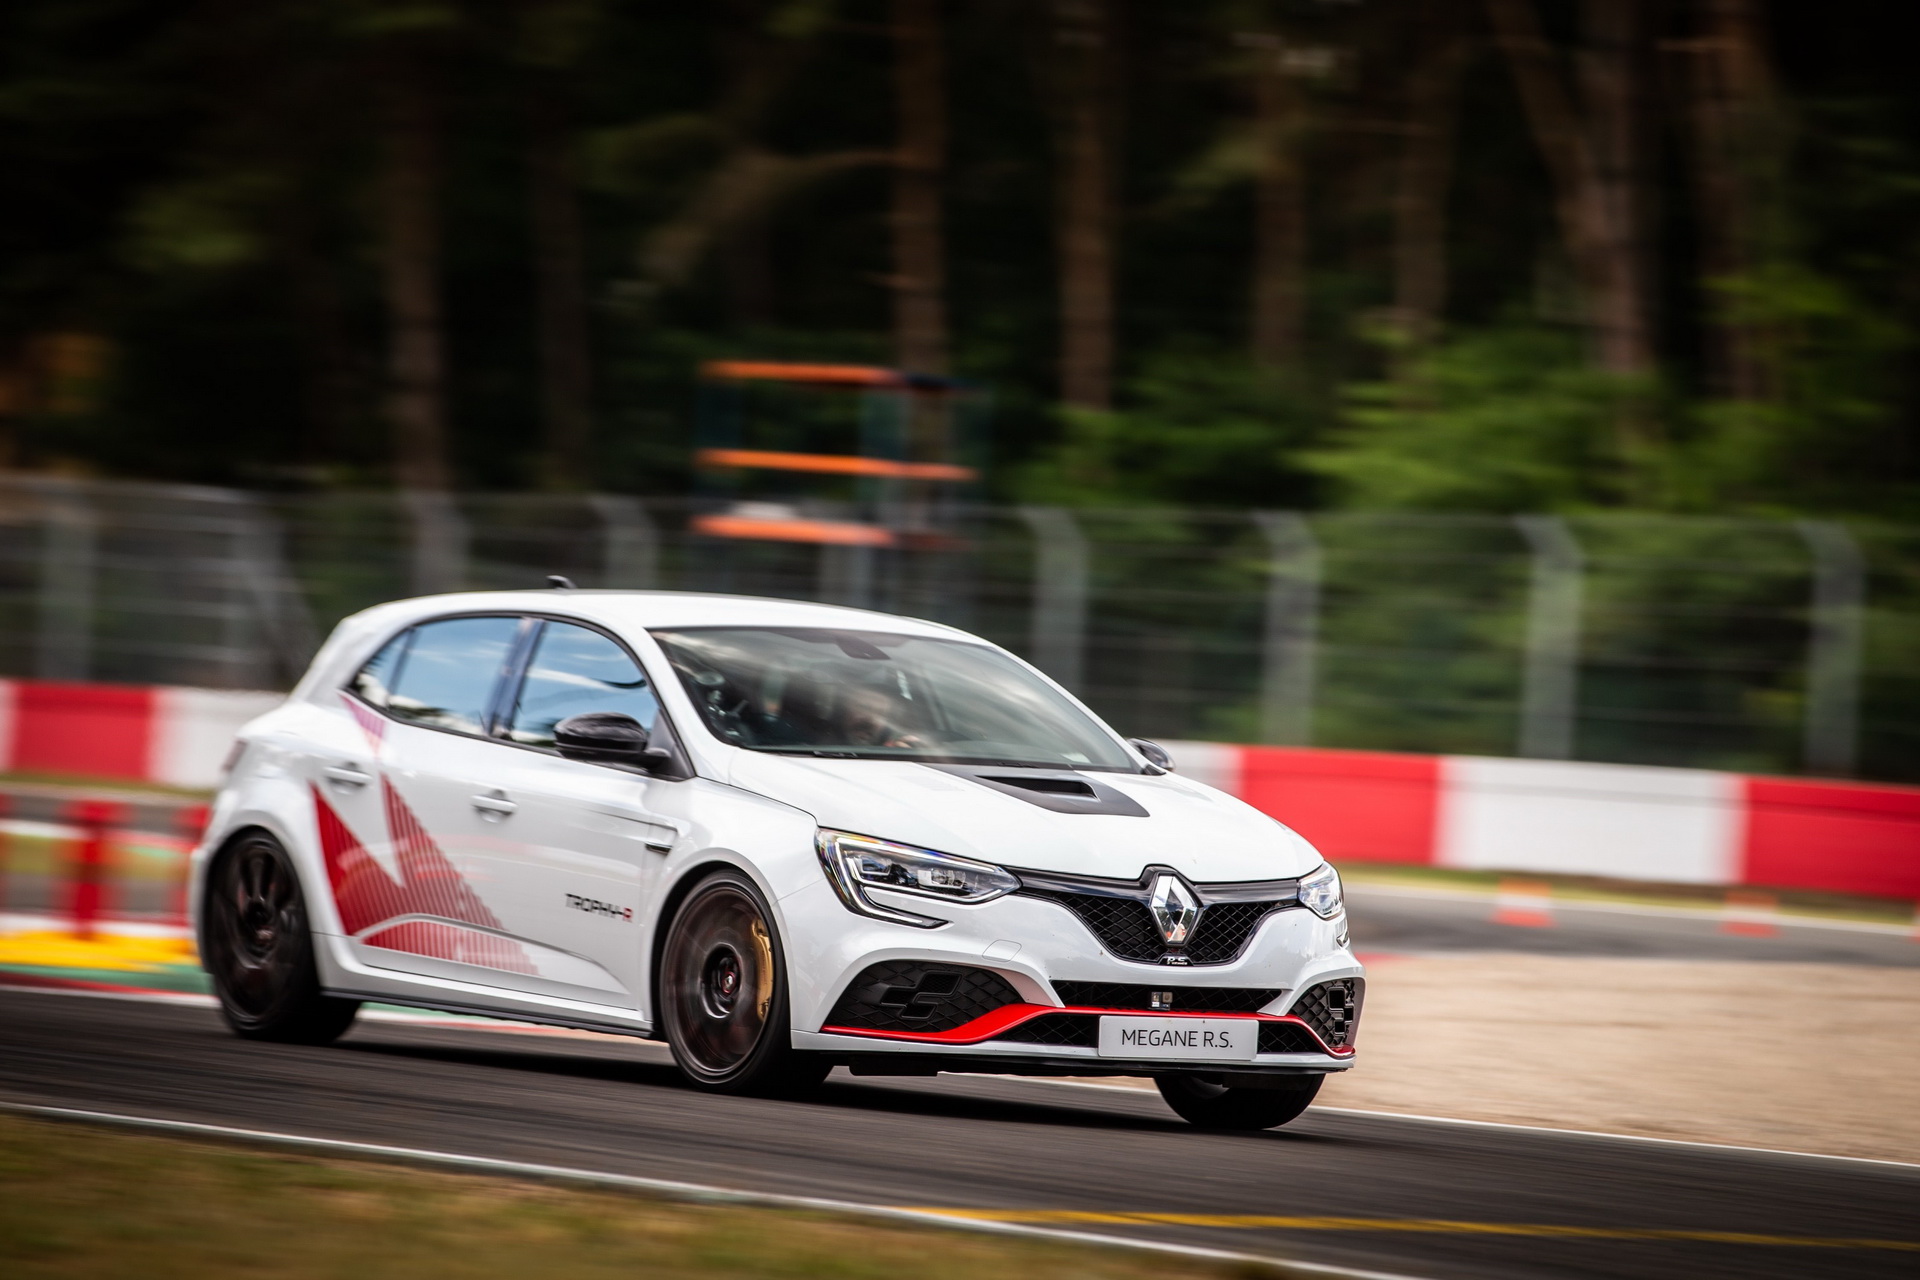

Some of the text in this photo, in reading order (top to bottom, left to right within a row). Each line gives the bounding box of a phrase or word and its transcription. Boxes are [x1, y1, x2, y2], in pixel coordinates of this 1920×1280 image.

[565, 893, 633, 922] TROPHY-R
[1121, 1029, 1233, 1048] MEGANE R.S.
